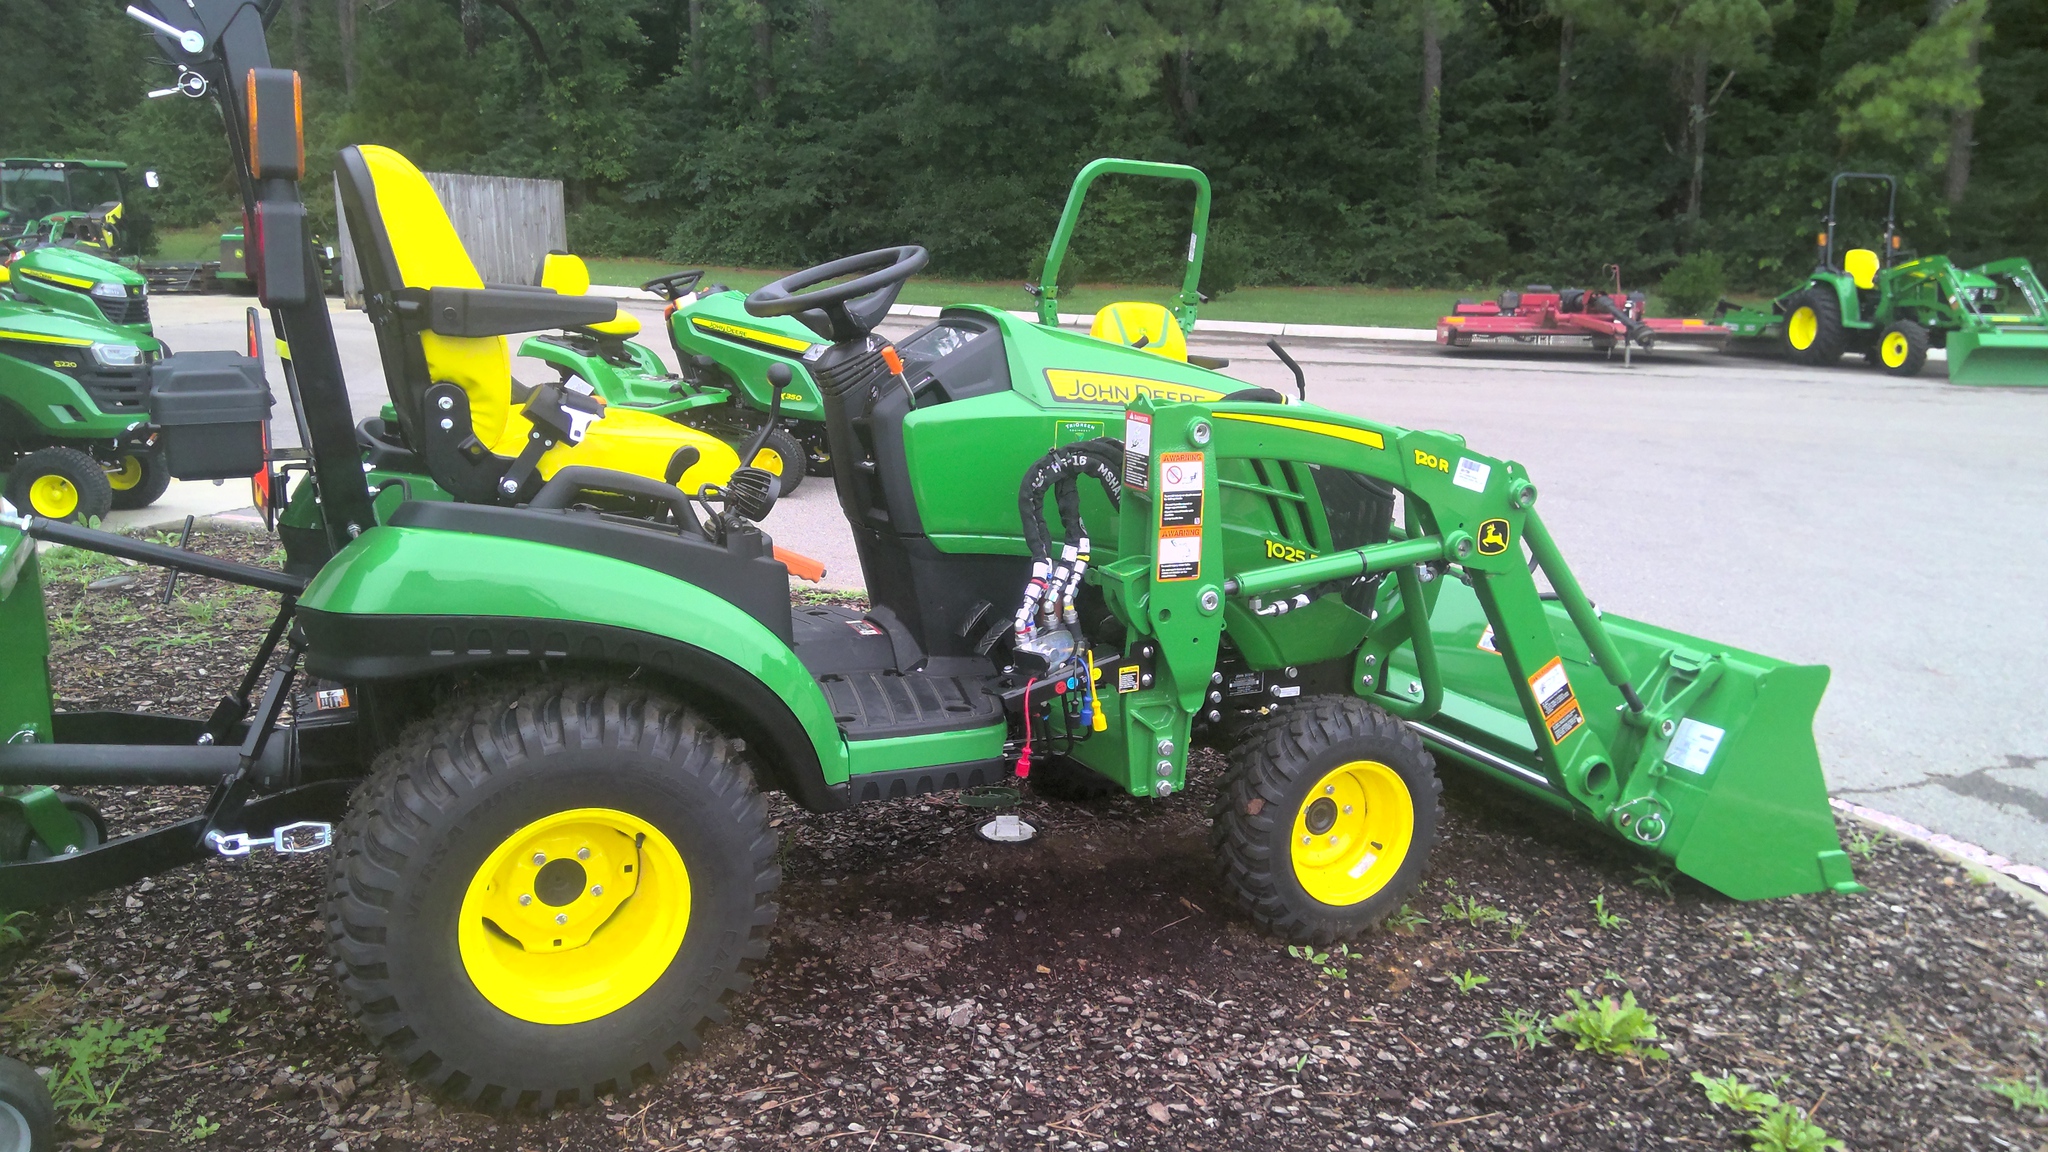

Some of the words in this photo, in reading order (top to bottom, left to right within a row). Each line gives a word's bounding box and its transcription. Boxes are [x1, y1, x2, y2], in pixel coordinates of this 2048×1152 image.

[1069, 379, 1130, 400] JOHN
[1171, 453, 1202, 462] WARNING
[1169, 529, 1200, 537] WARNING
